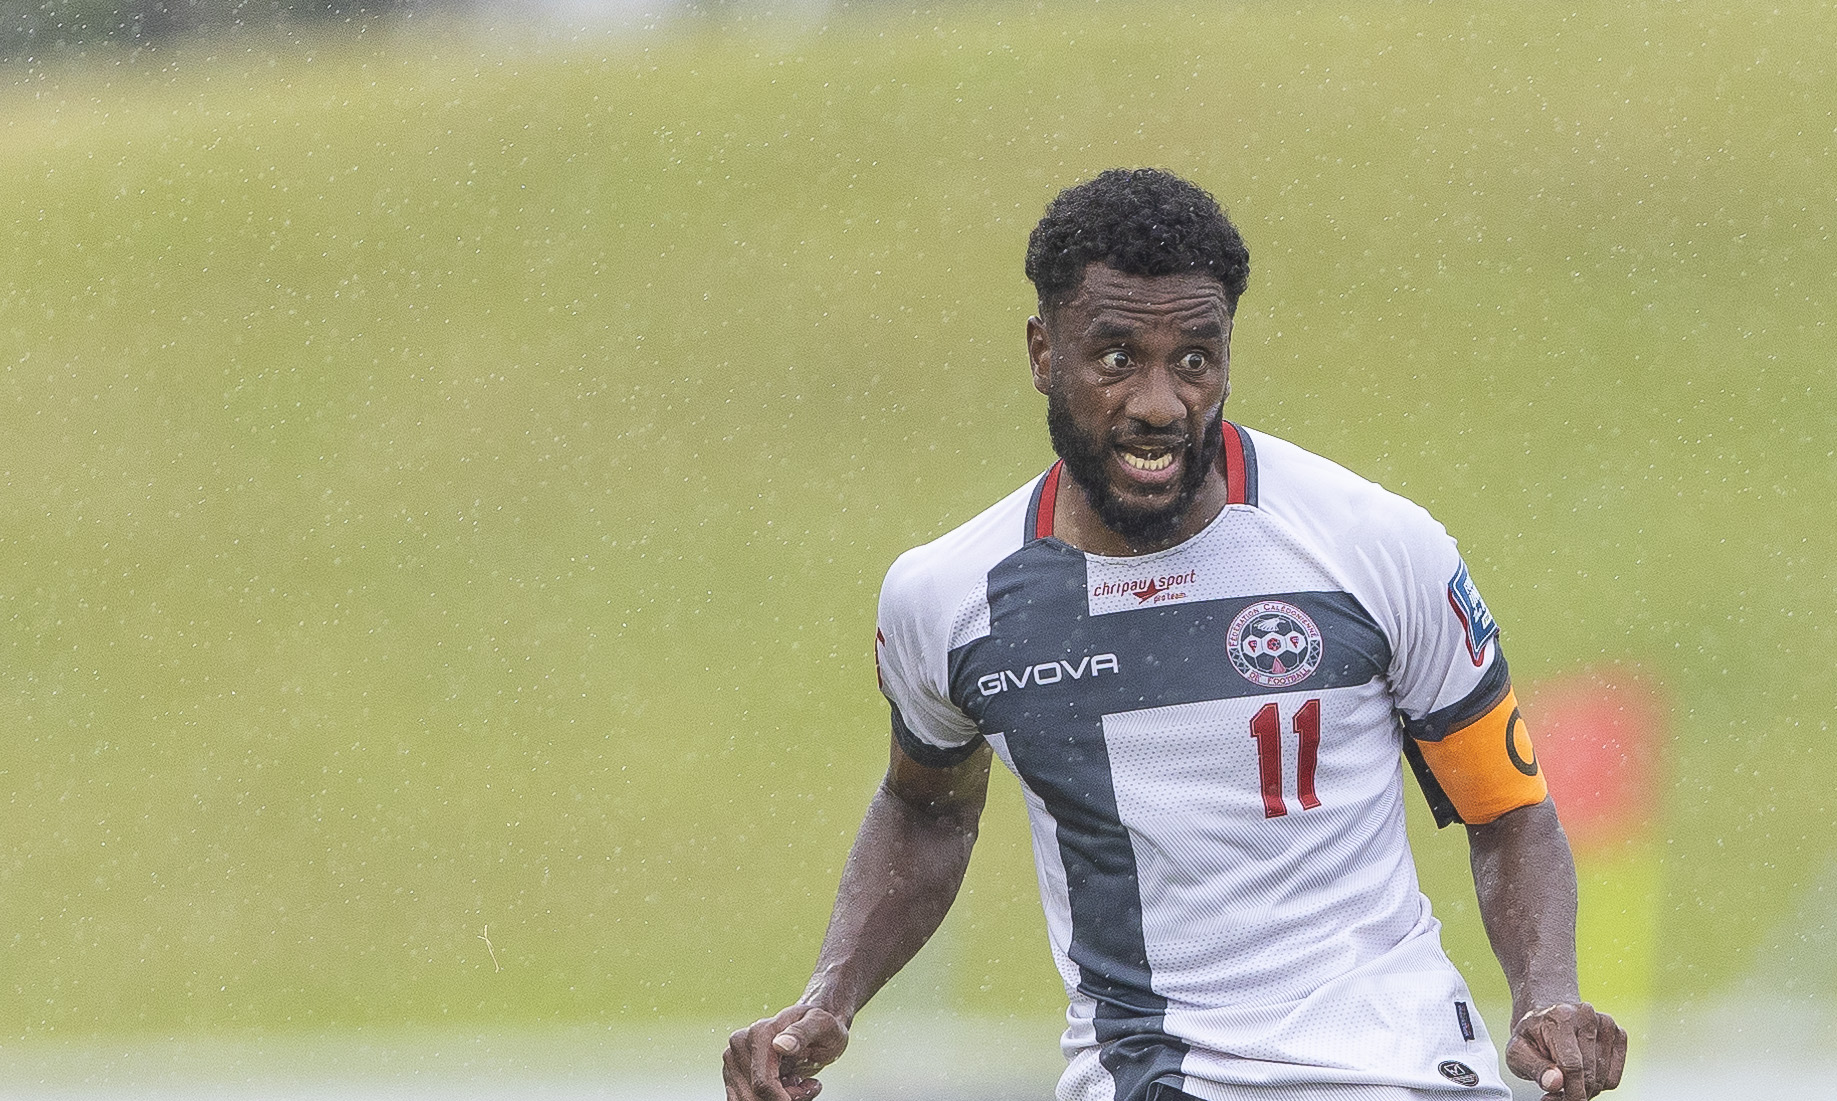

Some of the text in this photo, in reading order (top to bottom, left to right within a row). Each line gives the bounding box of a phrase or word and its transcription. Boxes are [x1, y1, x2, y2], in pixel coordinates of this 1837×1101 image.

[1093, 569, 1197, 597] chripau sport
[977, 653, 1120, 696] GIVOVA
[1249, 698, 1323, 820] 11
